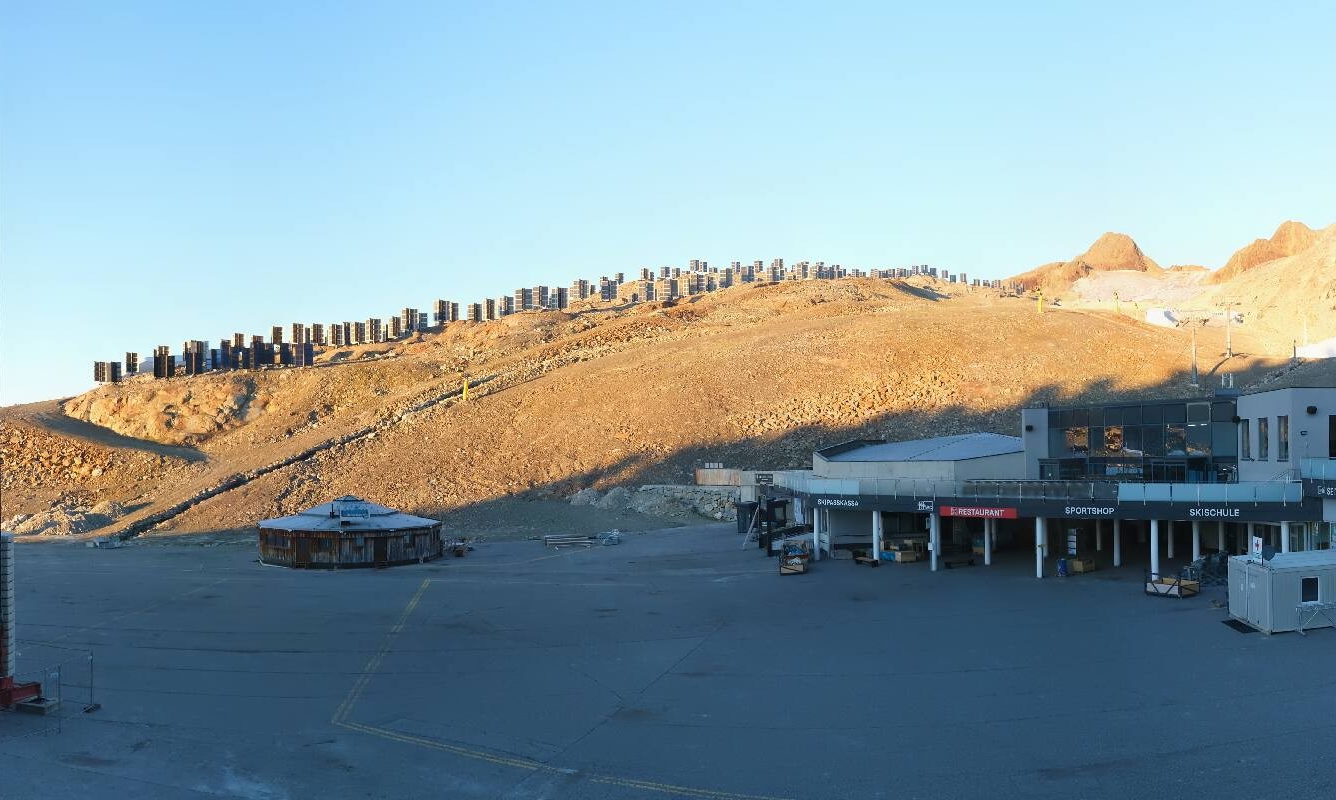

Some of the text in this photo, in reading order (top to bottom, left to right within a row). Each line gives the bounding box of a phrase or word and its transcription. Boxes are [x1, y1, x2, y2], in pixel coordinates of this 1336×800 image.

[817, 498, 859, 507] SKIPASSKASSA
[958, 508, 1005, 517] RESTAURANT
[1065, 506, 1115, 515] SPORTSHOP
[1189, 508, 1240, 517] SKISCHULE
